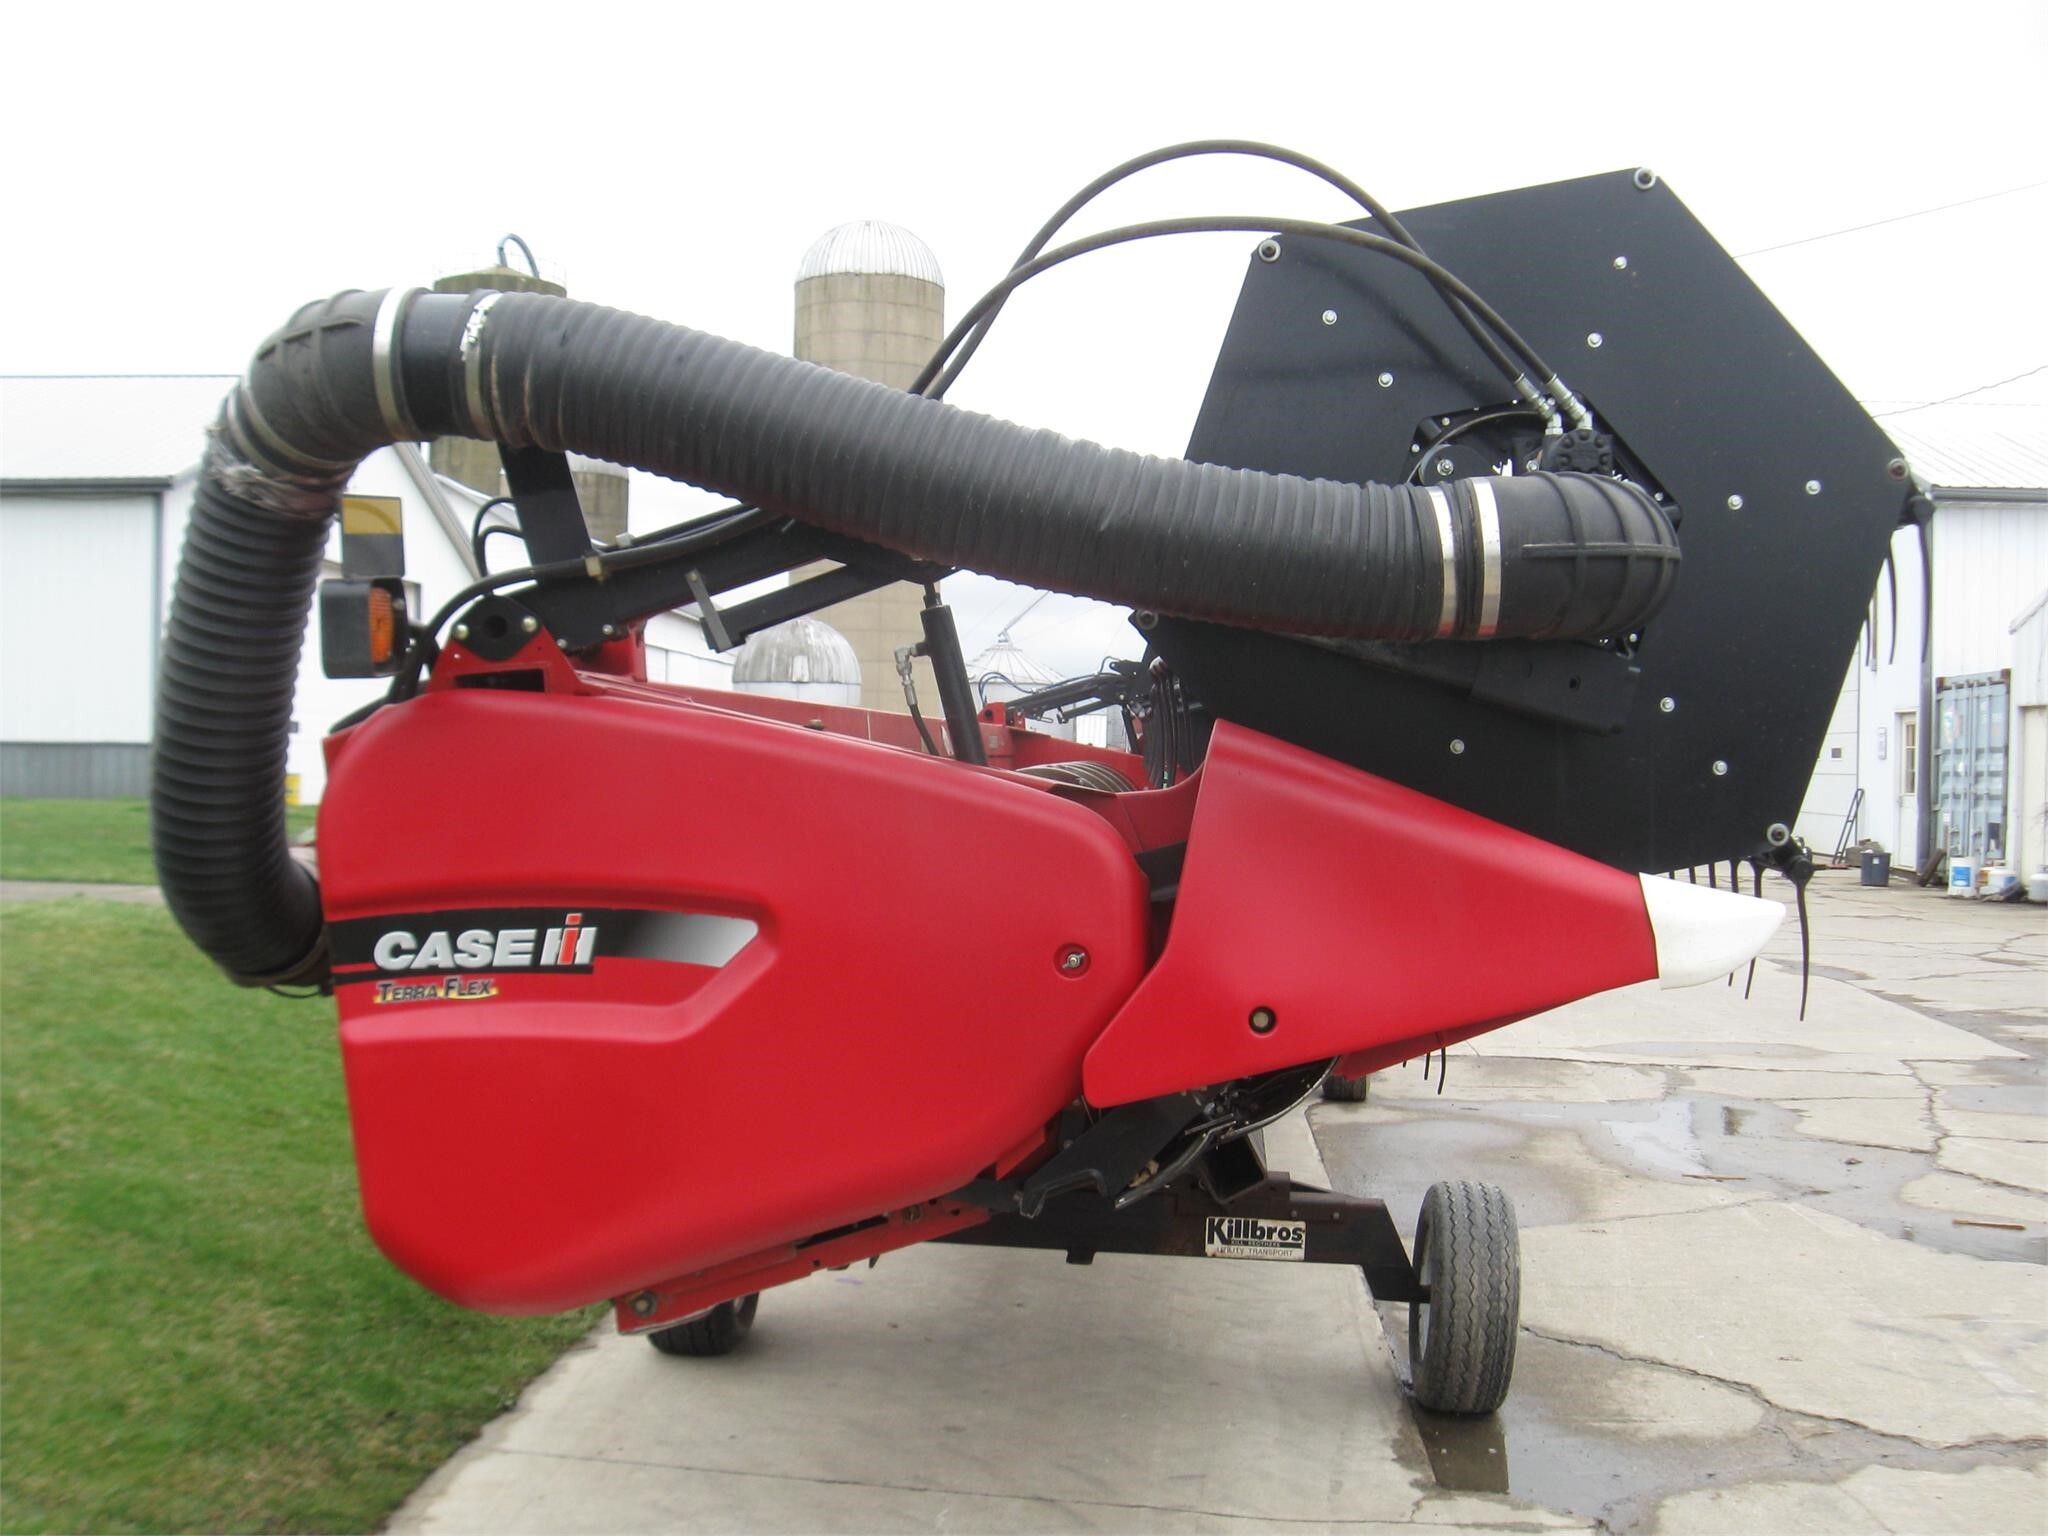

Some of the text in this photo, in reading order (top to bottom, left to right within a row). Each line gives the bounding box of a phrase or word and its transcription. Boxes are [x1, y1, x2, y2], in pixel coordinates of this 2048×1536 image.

[373, 929, 537, 970] CASE
[378, 976, 494, 1001] TERRA FLEX
[1207, 1218, 1303, 1246] Killbros
[1248, 1248, 1293, 1257] TRANSPORT
